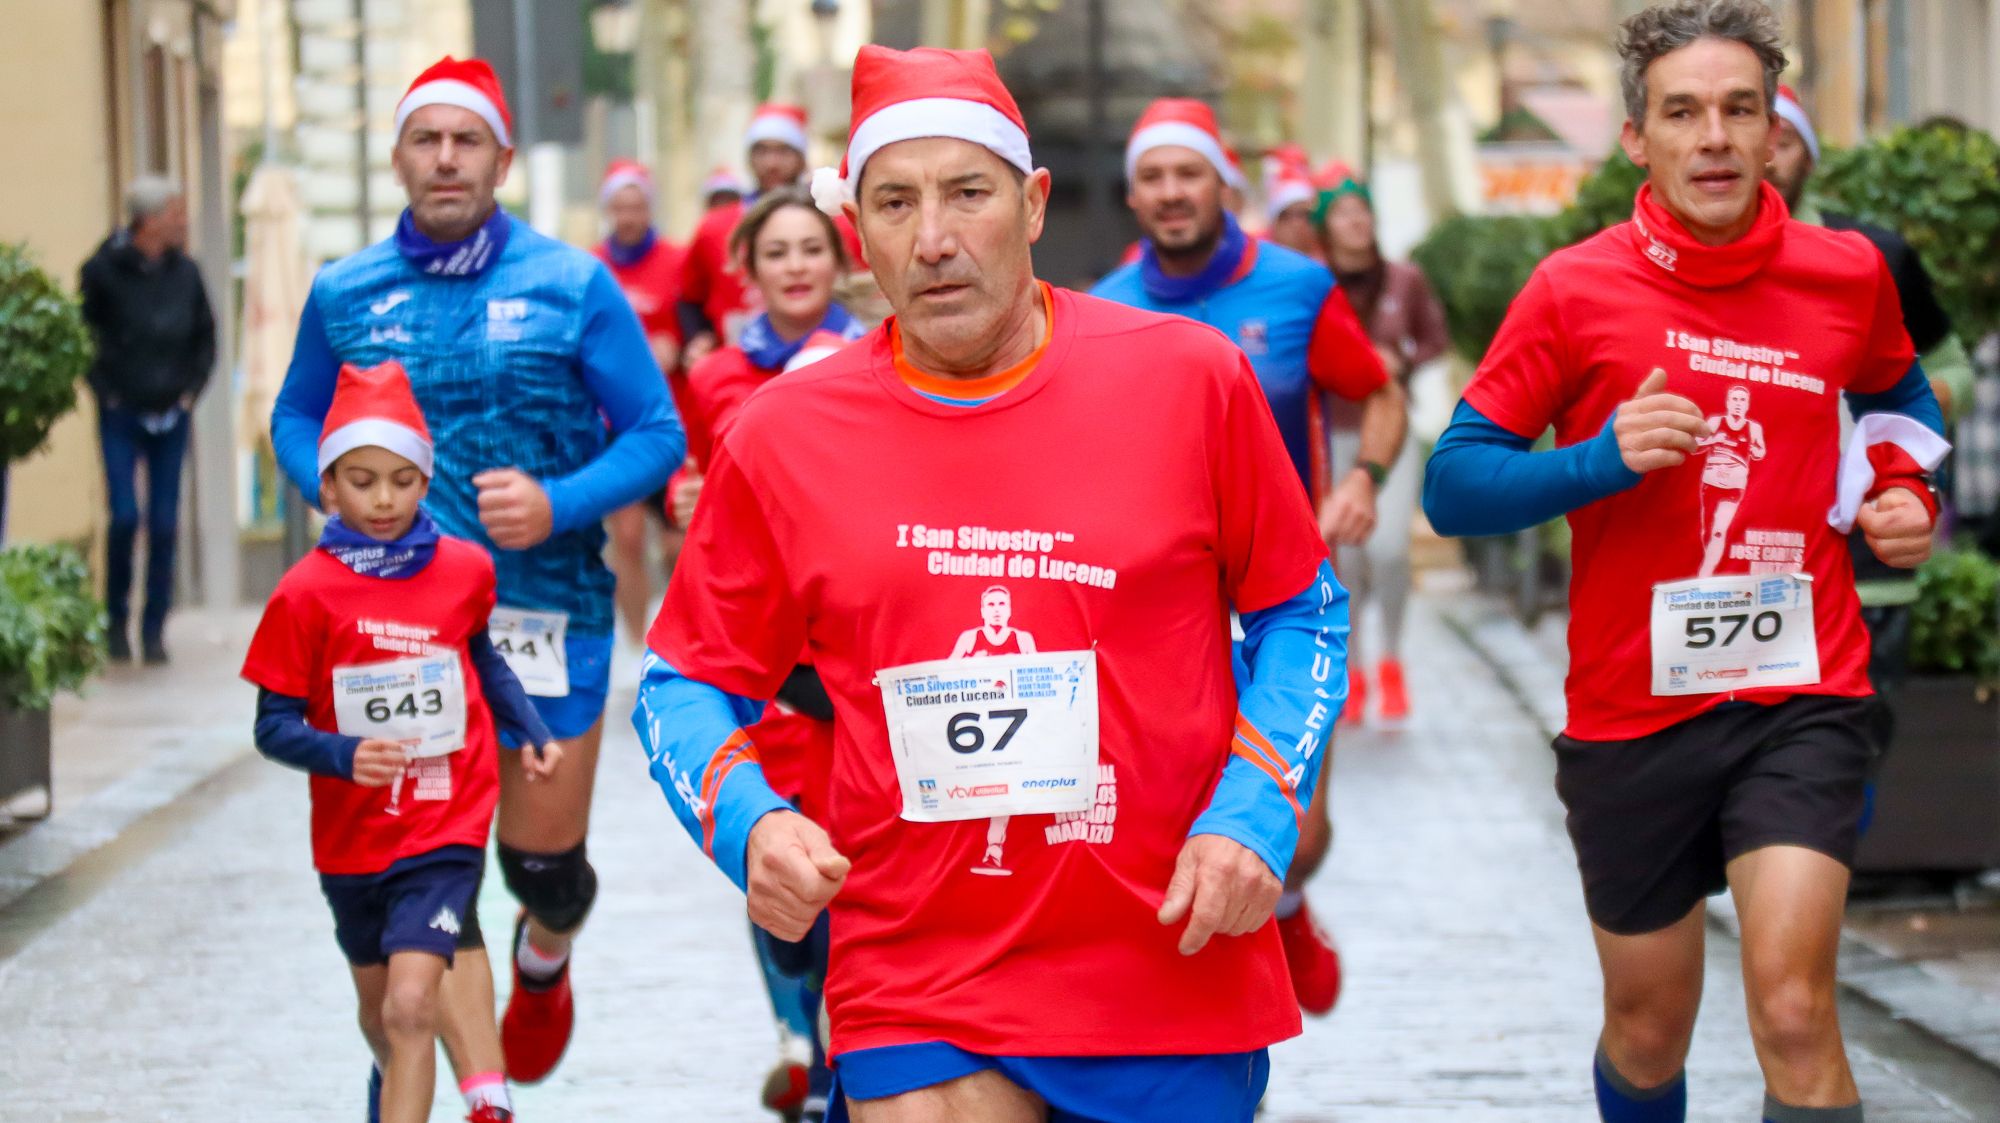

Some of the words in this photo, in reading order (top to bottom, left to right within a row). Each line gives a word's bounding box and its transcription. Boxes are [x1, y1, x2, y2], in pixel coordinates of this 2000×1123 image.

[1665, 330, 1675, 348] I
[1678, 332, 1710, 354] San
[1712, 338, 1784, 366] Silvestre
[1689, 353, 1747, 380] Ciudad
[1749, 365, 1771, 383] de
[1773, 367, 1825, 395] Lucena
[896, 524, 909, 547] I
[912, 525, 954, 549] San
[957, 526, 1054, 553] Silvestre
[1729, 544, 1761, 561] JOSE
[927, 551, 1005, 577] Ciudad
[1008, 554, 1036, 578] de
[1039, 555, 1118, 589] Lucena
[1685, 611, 1782, 649] 570
[905, 681, 924, 694] San
[927, 678, 977, 692] Silvestre
[906, 694, 941, 707] Ciudad
[944, 692, 958, 703] de
[961, 690, 1005, 702] Lucena
[365, 688, 443, 723] 643
[946, 707, 1028, 754] 67
[1021, 777, 1078, 789] enerplus
